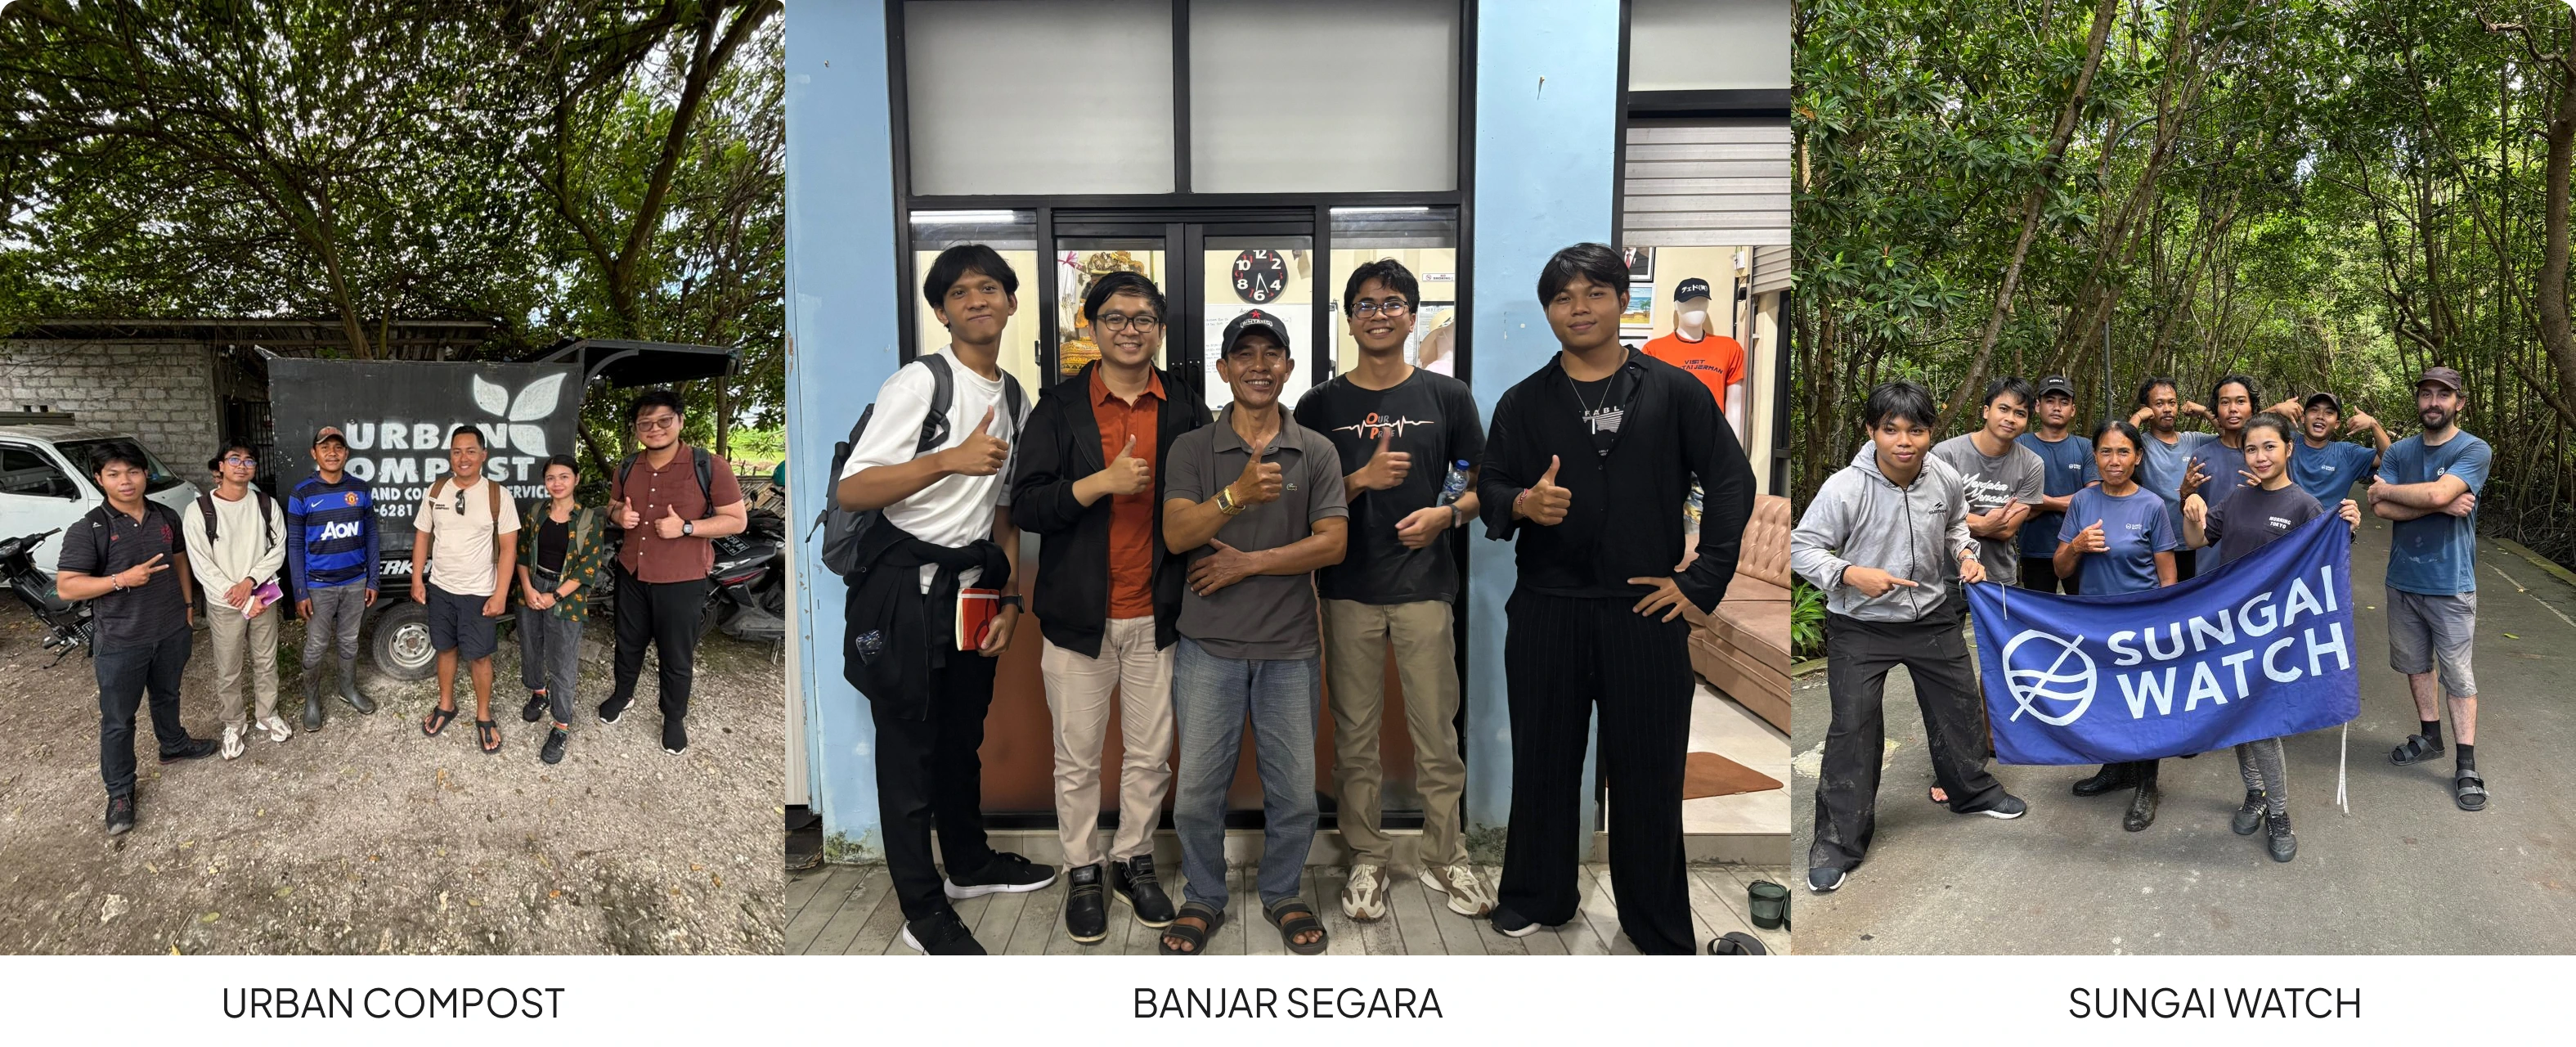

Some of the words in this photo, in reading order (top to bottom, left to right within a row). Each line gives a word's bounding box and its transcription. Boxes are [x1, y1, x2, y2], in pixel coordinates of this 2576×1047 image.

[1253, 249, 1267, 259] 12
[1236, 259, 1251, 271] 10
[1271, 258, 1281, 269] 2
[1236, 279, 1249, 290] 8
[1270, 280, 1281, 290] 4
[1253, 290, 1265, 301] 6
[1694, 365, 1723, 374] JERMAN
[1366, 412, 1389, 425] OUR
[1370, 427, 1395, 439] PRE
[316, 456, 536, 483] OMPST
[370, 487, 402, 501] AND
[507, 484, 552, 499] ERVICE
[2269, 516, 2291, 525] MORNING
[321, 521, 359, 541] AON
[2107, 565, 2338, 666] SUNGAI
[2116, 622, 2350, 720] WATCH
